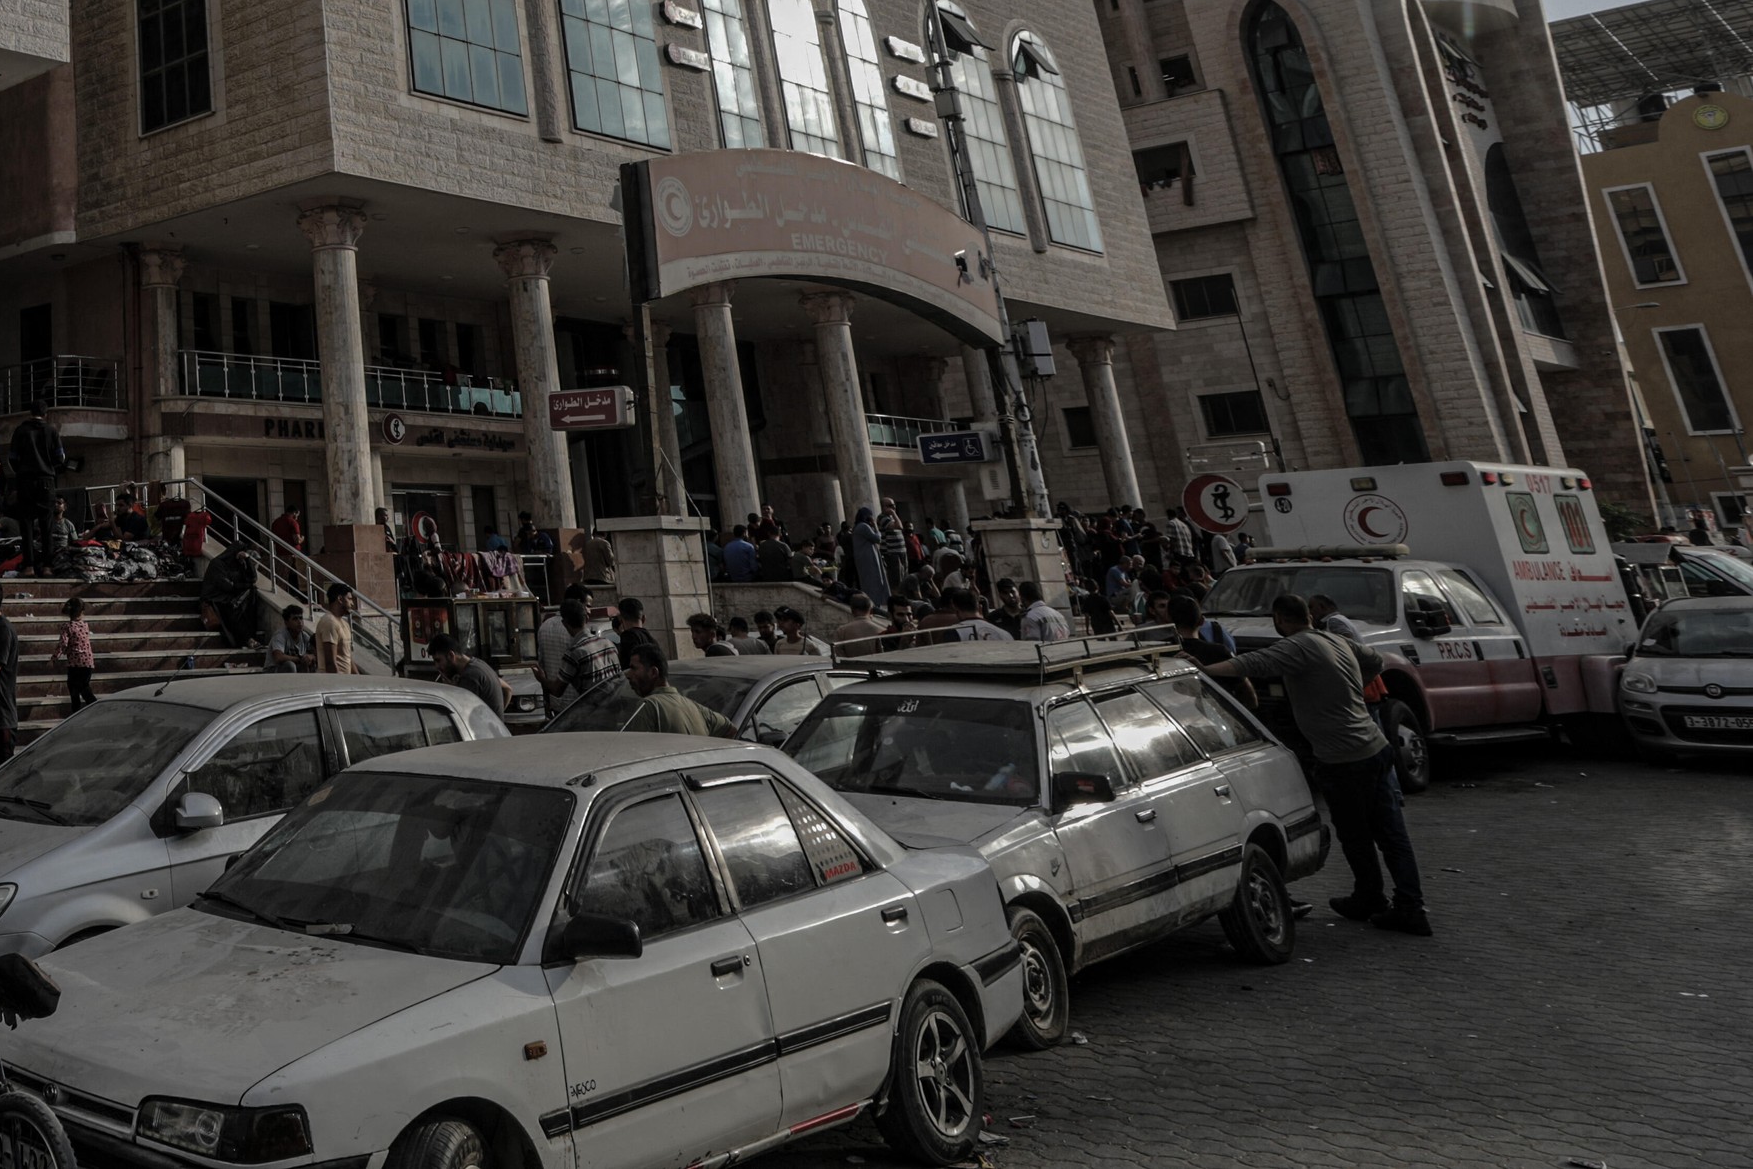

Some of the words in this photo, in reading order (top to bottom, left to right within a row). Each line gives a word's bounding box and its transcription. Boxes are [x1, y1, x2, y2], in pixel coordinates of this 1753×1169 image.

[697, 191, 770, 229] الطوارئ
[775, 191, 827, 229] مدخل
[792, 232, 891, 266] EMERGENCY
[553, 395, 583, 411] الطوارئ
[584, 394, 611, 409] مدخل
[416, 428, 444, 446] القدس
[448, 429, 482, 448] مستشفى
[1525, 474, 1552, 494] 0517
[1559, 501, 1592, 548] 101
[1512, 560, 1567, 581] AMBULANCE
[824, 861, 858, 880] MAZDA
